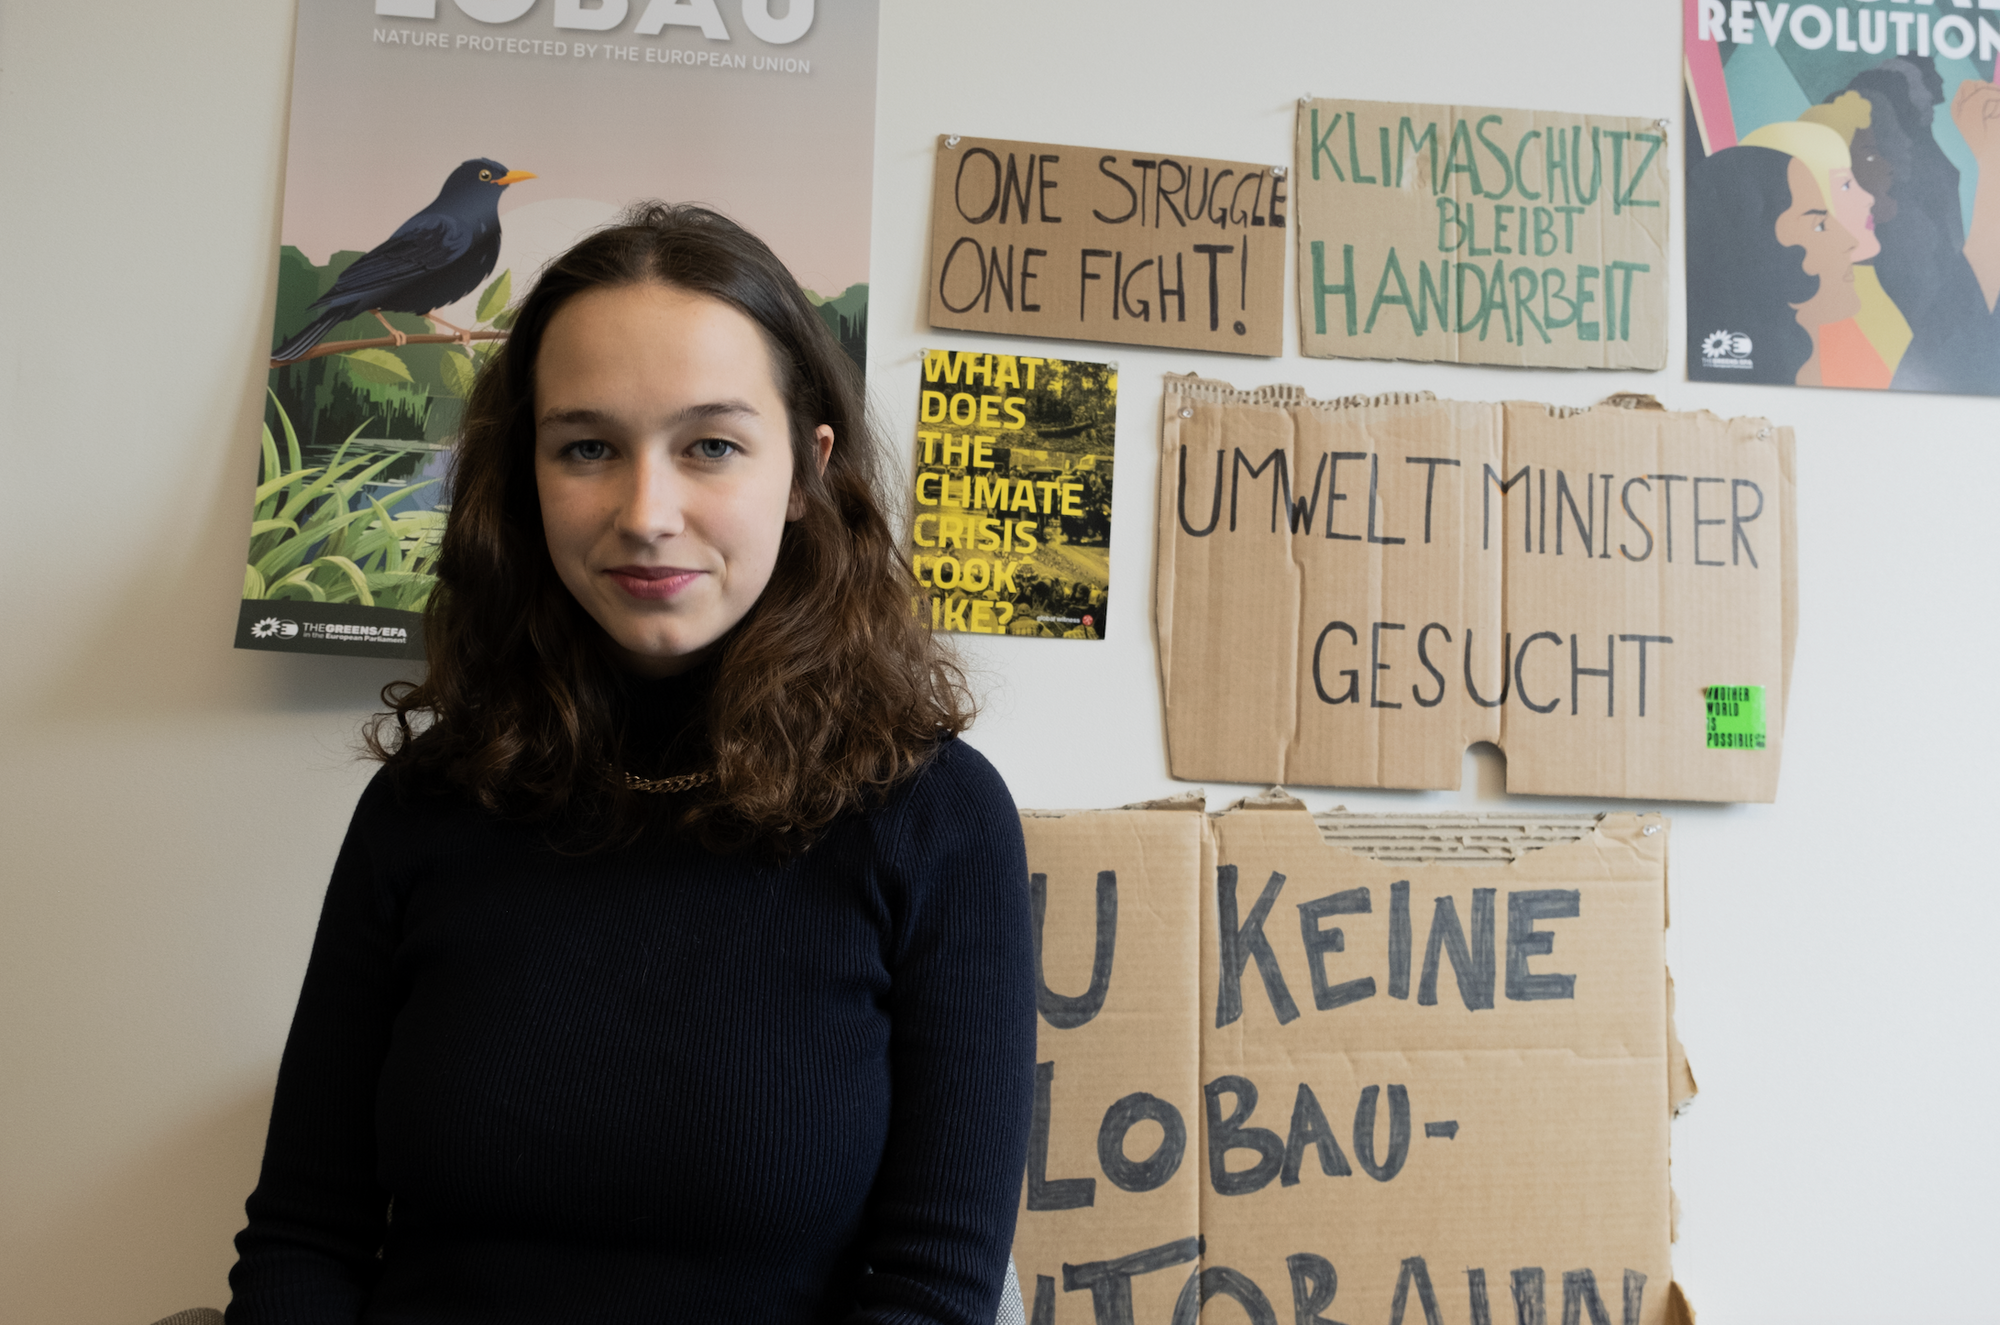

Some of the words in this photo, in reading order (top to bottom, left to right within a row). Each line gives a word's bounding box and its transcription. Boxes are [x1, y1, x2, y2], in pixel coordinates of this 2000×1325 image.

[373, 28, 449, 48] NATURE
[456, 34, 568, 56] PROTECTED
[574, 42, 598, 58] BY
[603, 44, 639, 61] THE
[645, 47, 747, 69] EUROPEAN
[752, 55, 810, 74] UNION
[1309, 107, 1662, 215] KLIMASCHUTZ
[954, 147, 1062, 224] ONE
[1092, 155, 1286, 229] STRUGGLE
[1436, 196, 1586, 257] BLEIBT
[939, 236, 1047, 314] ONE
[1080, 234, 1249, 337] FIGHT!
[1310, 239, 1650, 346] HANDARBEIT
[923, 351, 1044, 390] WHAT
[921, 390, 1026, 430] DOES
[917, 430, 996, 468] THE
[916, 472, 1084, 516] CLIMATE
[1177, 444, 1460, 545] UMWELT
[1482, 461, 1764, 569] MINISTER
[913, 513, 1038, 554] CRISIS
[913, 554, 1018, 593] LOOK
[325, 633, 363, 641] European
[364, 635, 406, 644] Parliament
[1312, 620, 1673, 718] GESUCHT
[1707, 702, 1739, 716] WORLD
[1707, 717, 1716, 731] IS
[1707, 733, 1753, 748] POSSIBLE
[1215, 864, 1580, 1029] KEINE
[1027, 1060, 1460, 1212] LOBAU-
